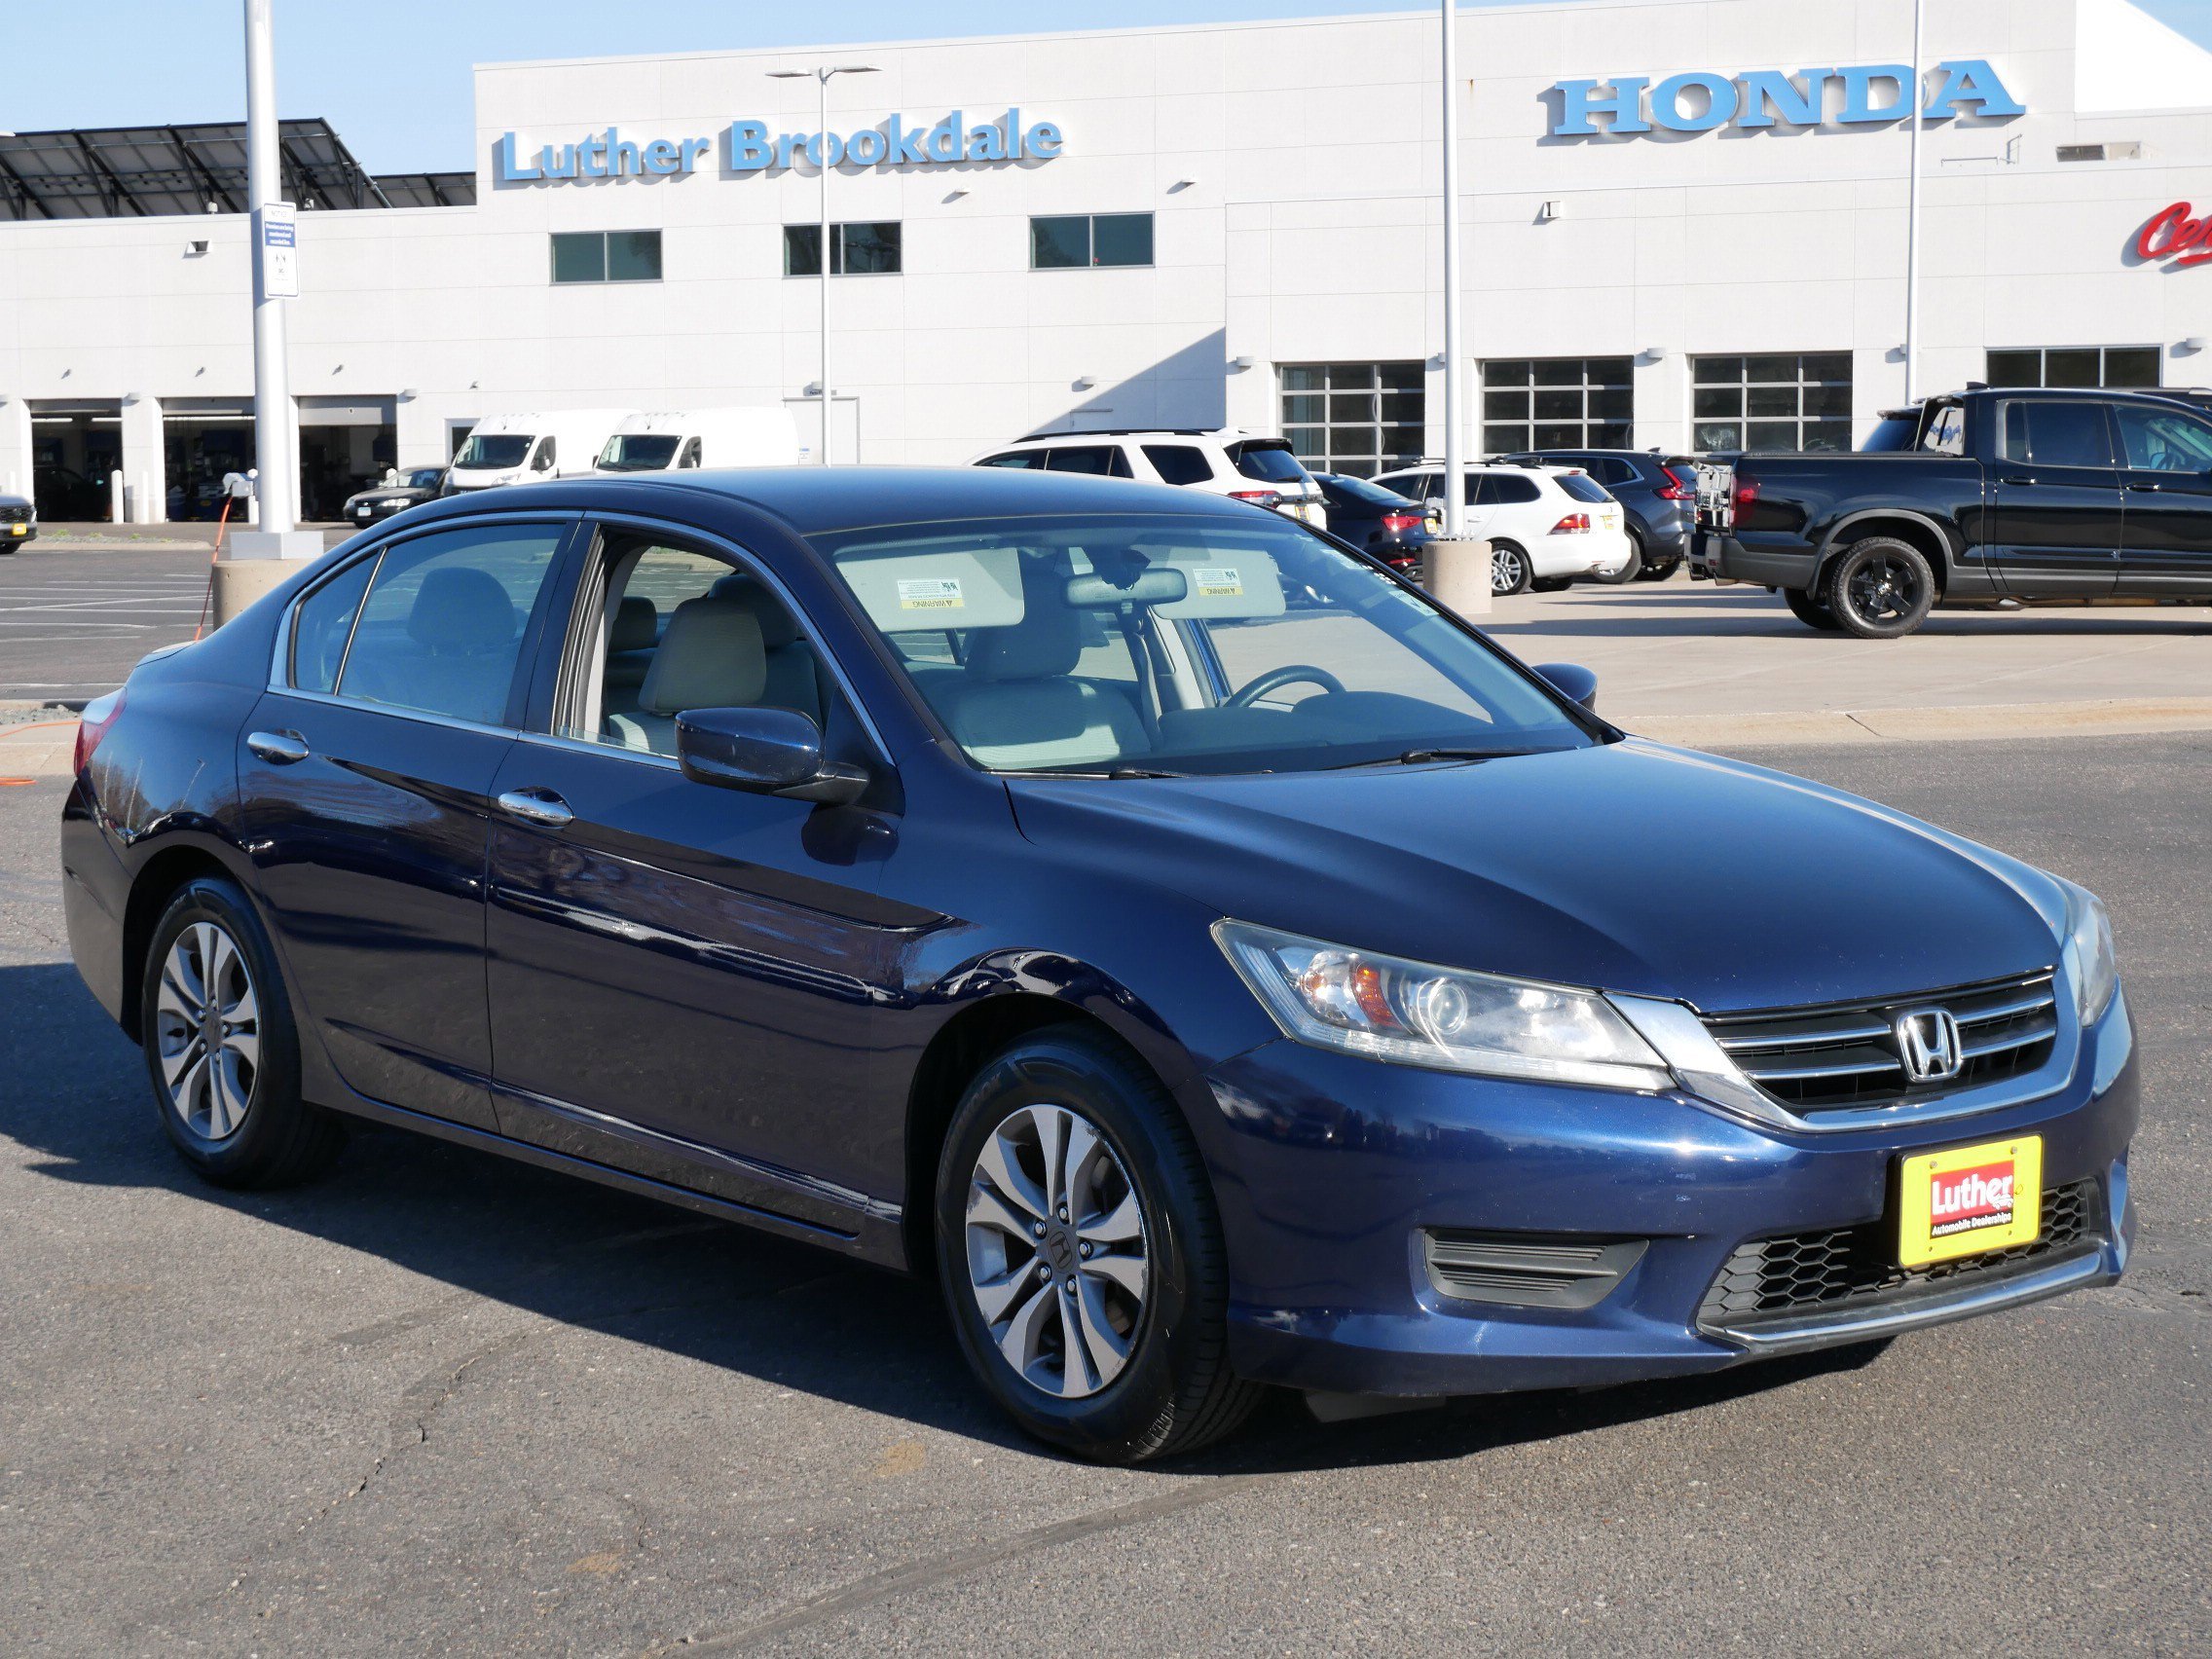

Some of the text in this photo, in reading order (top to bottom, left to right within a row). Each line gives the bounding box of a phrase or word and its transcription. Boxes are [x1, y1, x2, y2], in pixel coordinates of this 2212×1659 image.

[1555, 59, 2026, 135] HONDA
[503, 107, 1062, 180] Luther Brookdale
[1932, 1173, 2013, 1215] Luther
[1932, 1212, 2011, 1235] Automobile Dealerships
